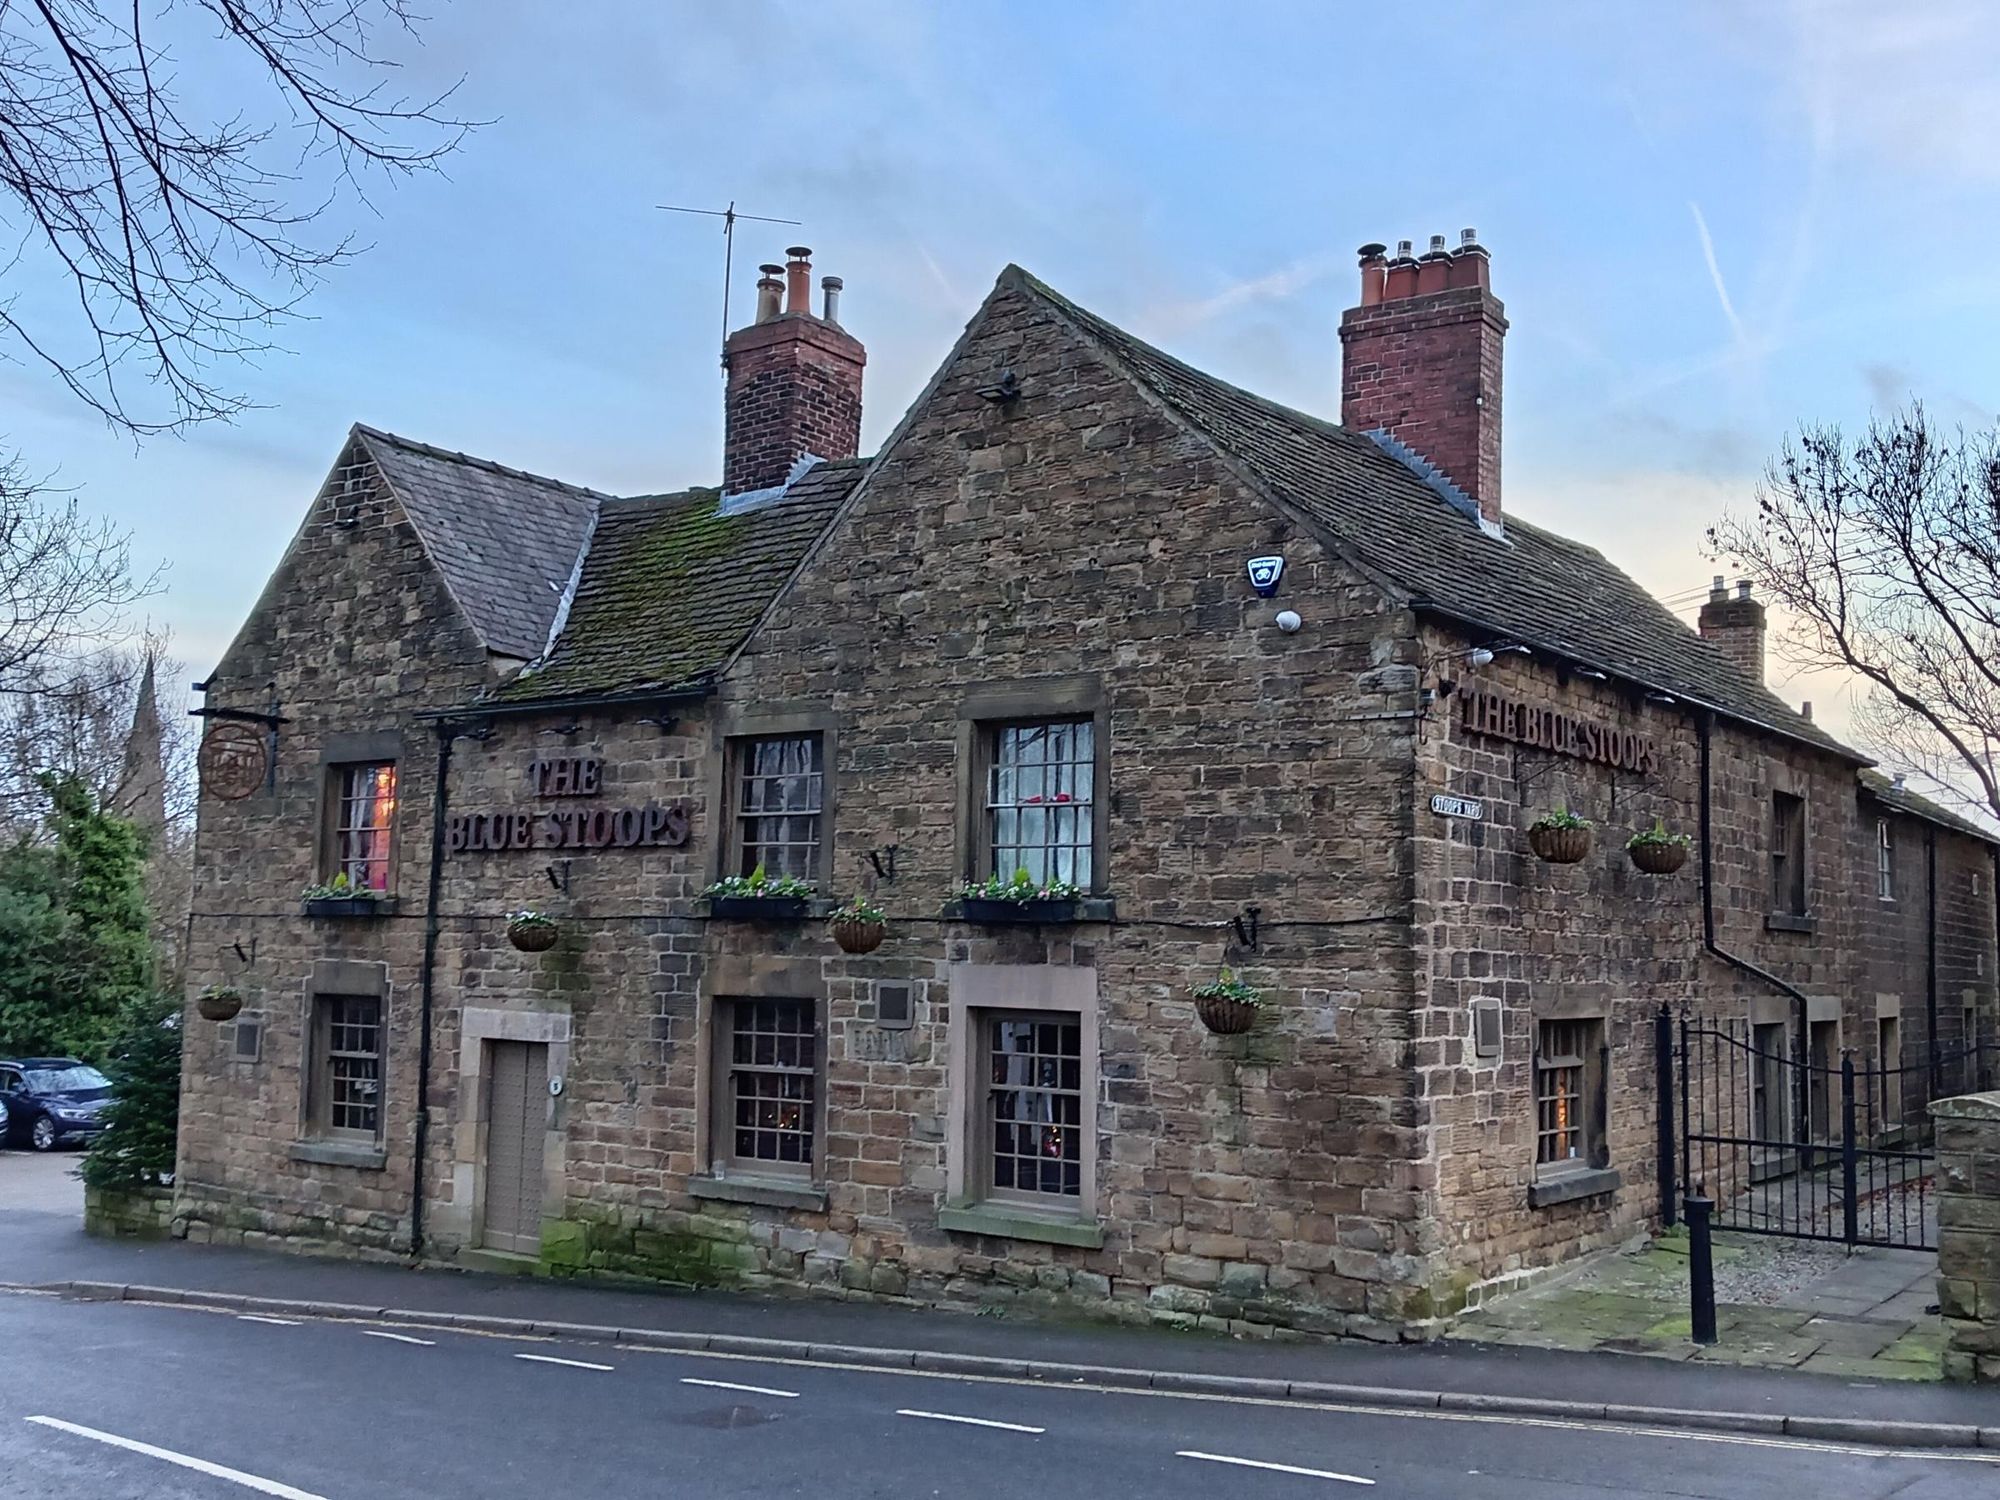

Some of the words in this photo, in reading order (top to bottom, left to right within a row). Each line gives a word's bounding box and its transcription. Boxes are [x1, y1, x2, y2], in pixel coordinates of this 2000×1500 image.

[1464, 689, 1518, 743] THE
[1524, 706, 1581, 757] BLUE
[1583, 721, 1659, 775] STOOPS
[529, 757, 602, 798] THE
[444, 811, 533, 850] BLUE
[544, 803, 690, 848] STOOPS
